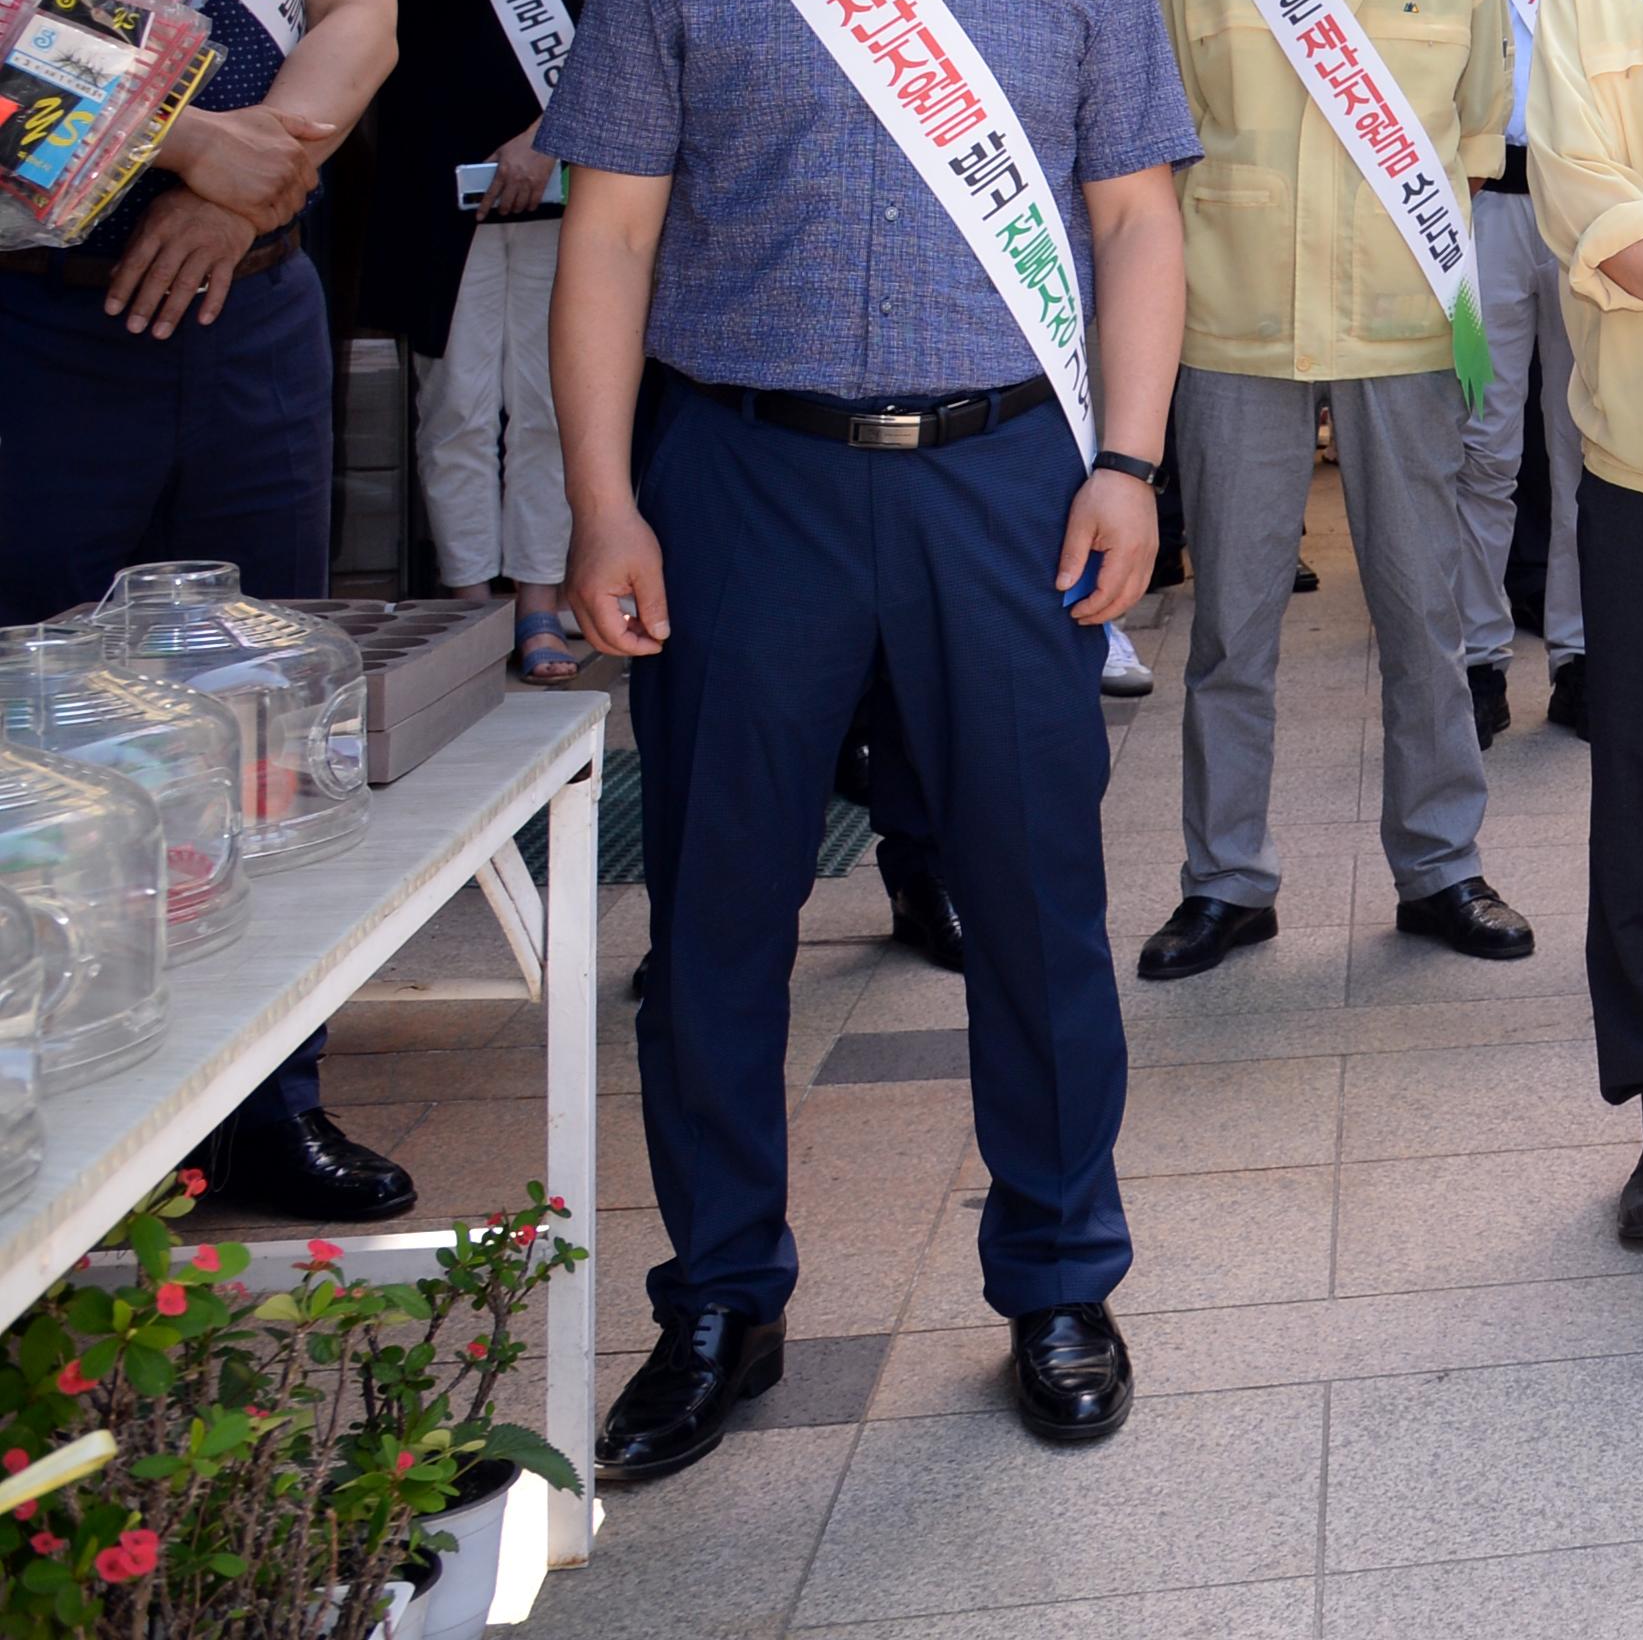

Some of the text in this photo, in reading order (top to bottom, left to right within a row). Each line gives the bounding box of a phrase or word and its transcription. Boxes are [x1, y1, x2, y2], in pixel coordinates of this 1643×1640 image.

[1295, 12, 1422, 180] 재난지원금
[947, 131, 1029, 222] 받고
[995, 202, 1083, 348] 전통시장
